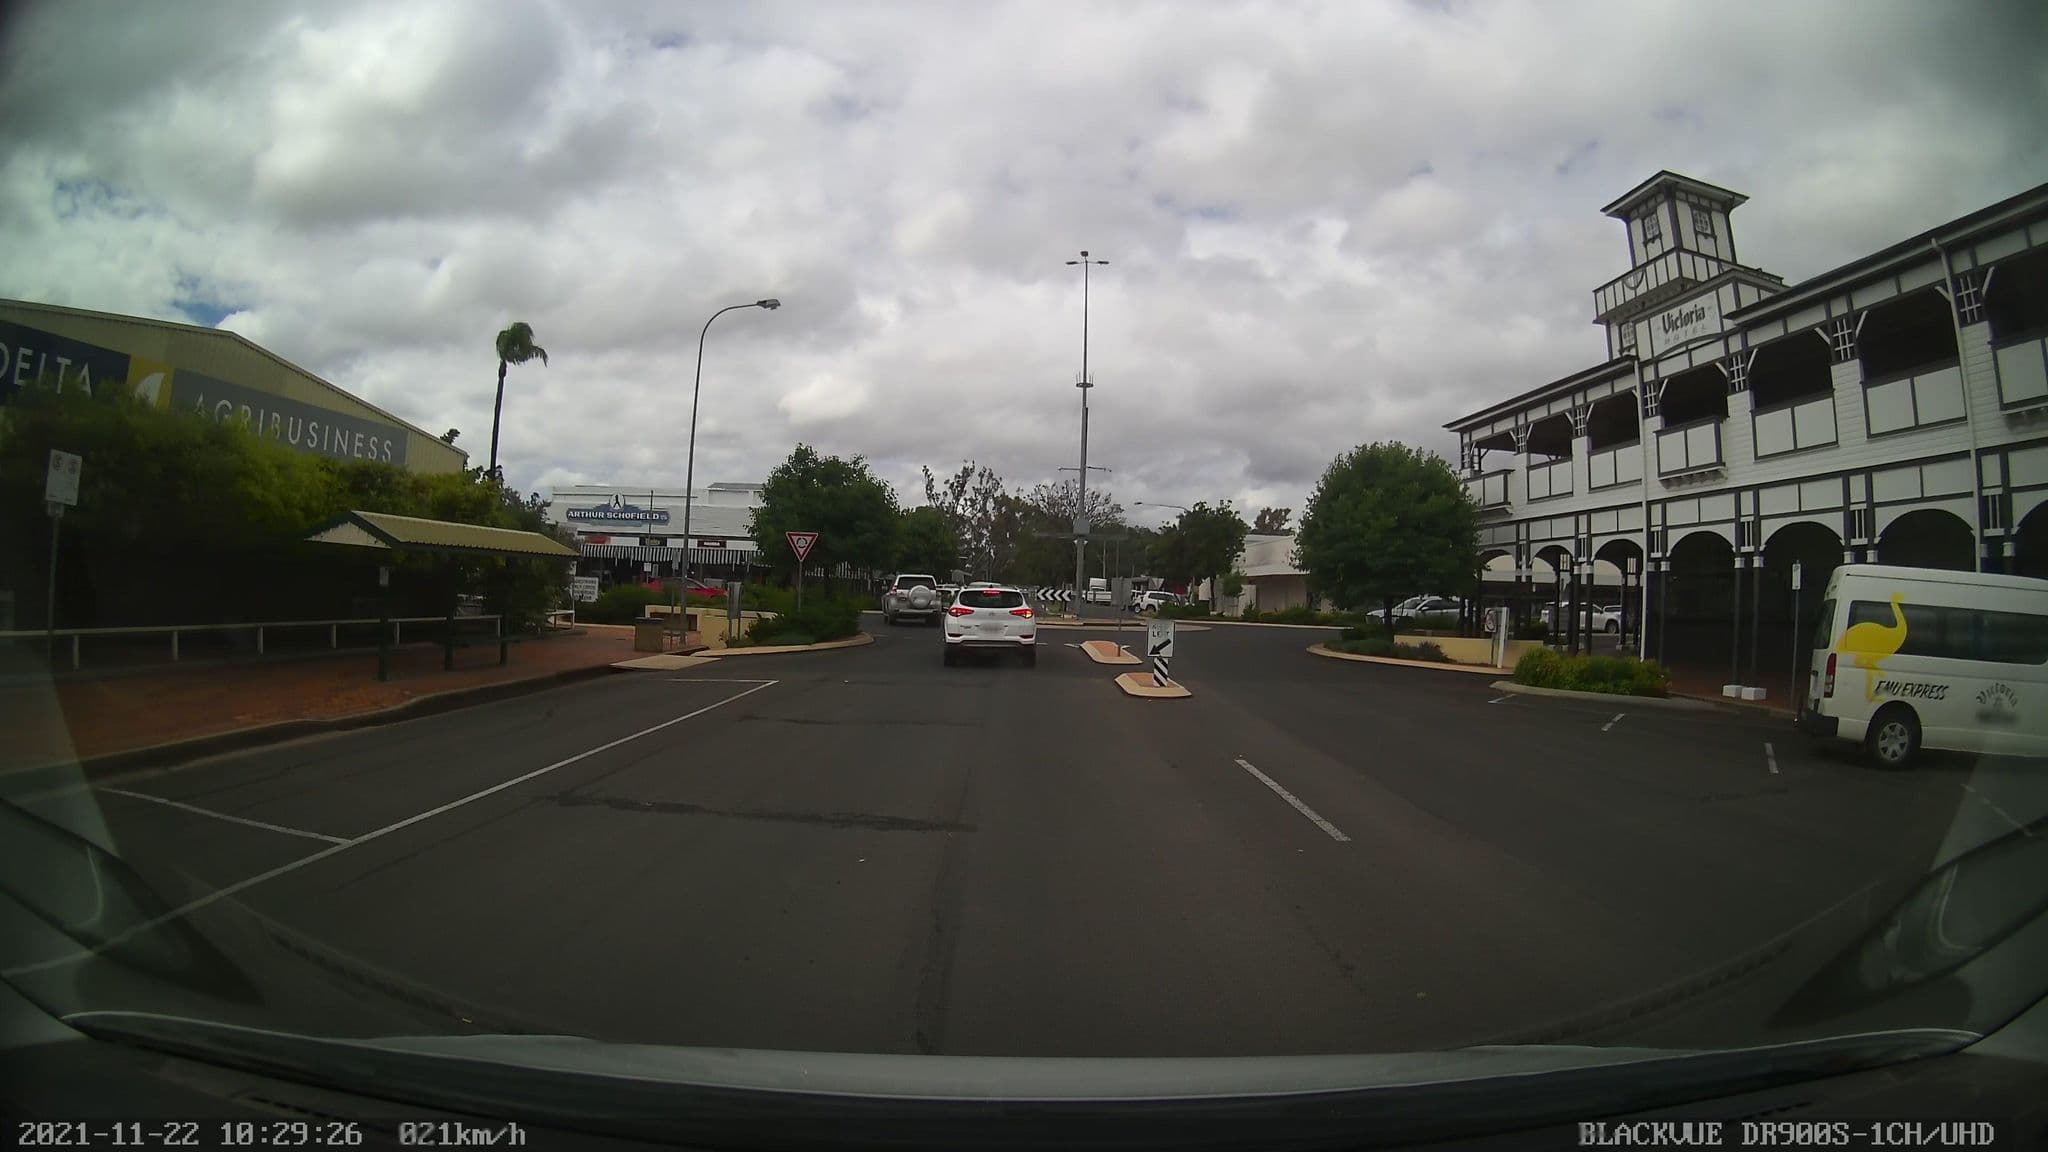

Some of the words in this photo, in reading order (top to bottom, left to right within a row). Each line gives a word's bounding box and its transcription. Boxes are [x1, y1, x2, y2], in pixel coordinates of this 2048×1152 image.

[1662, 304, 1705, 334] Victoria
[568, 511, 605, 520] ARTHUR
[606, 511, 659, 521] SCHOFIELD
[1875, 681, 1900, 696] EMU
[1901, 682, 1950, 701] EXPRESS
